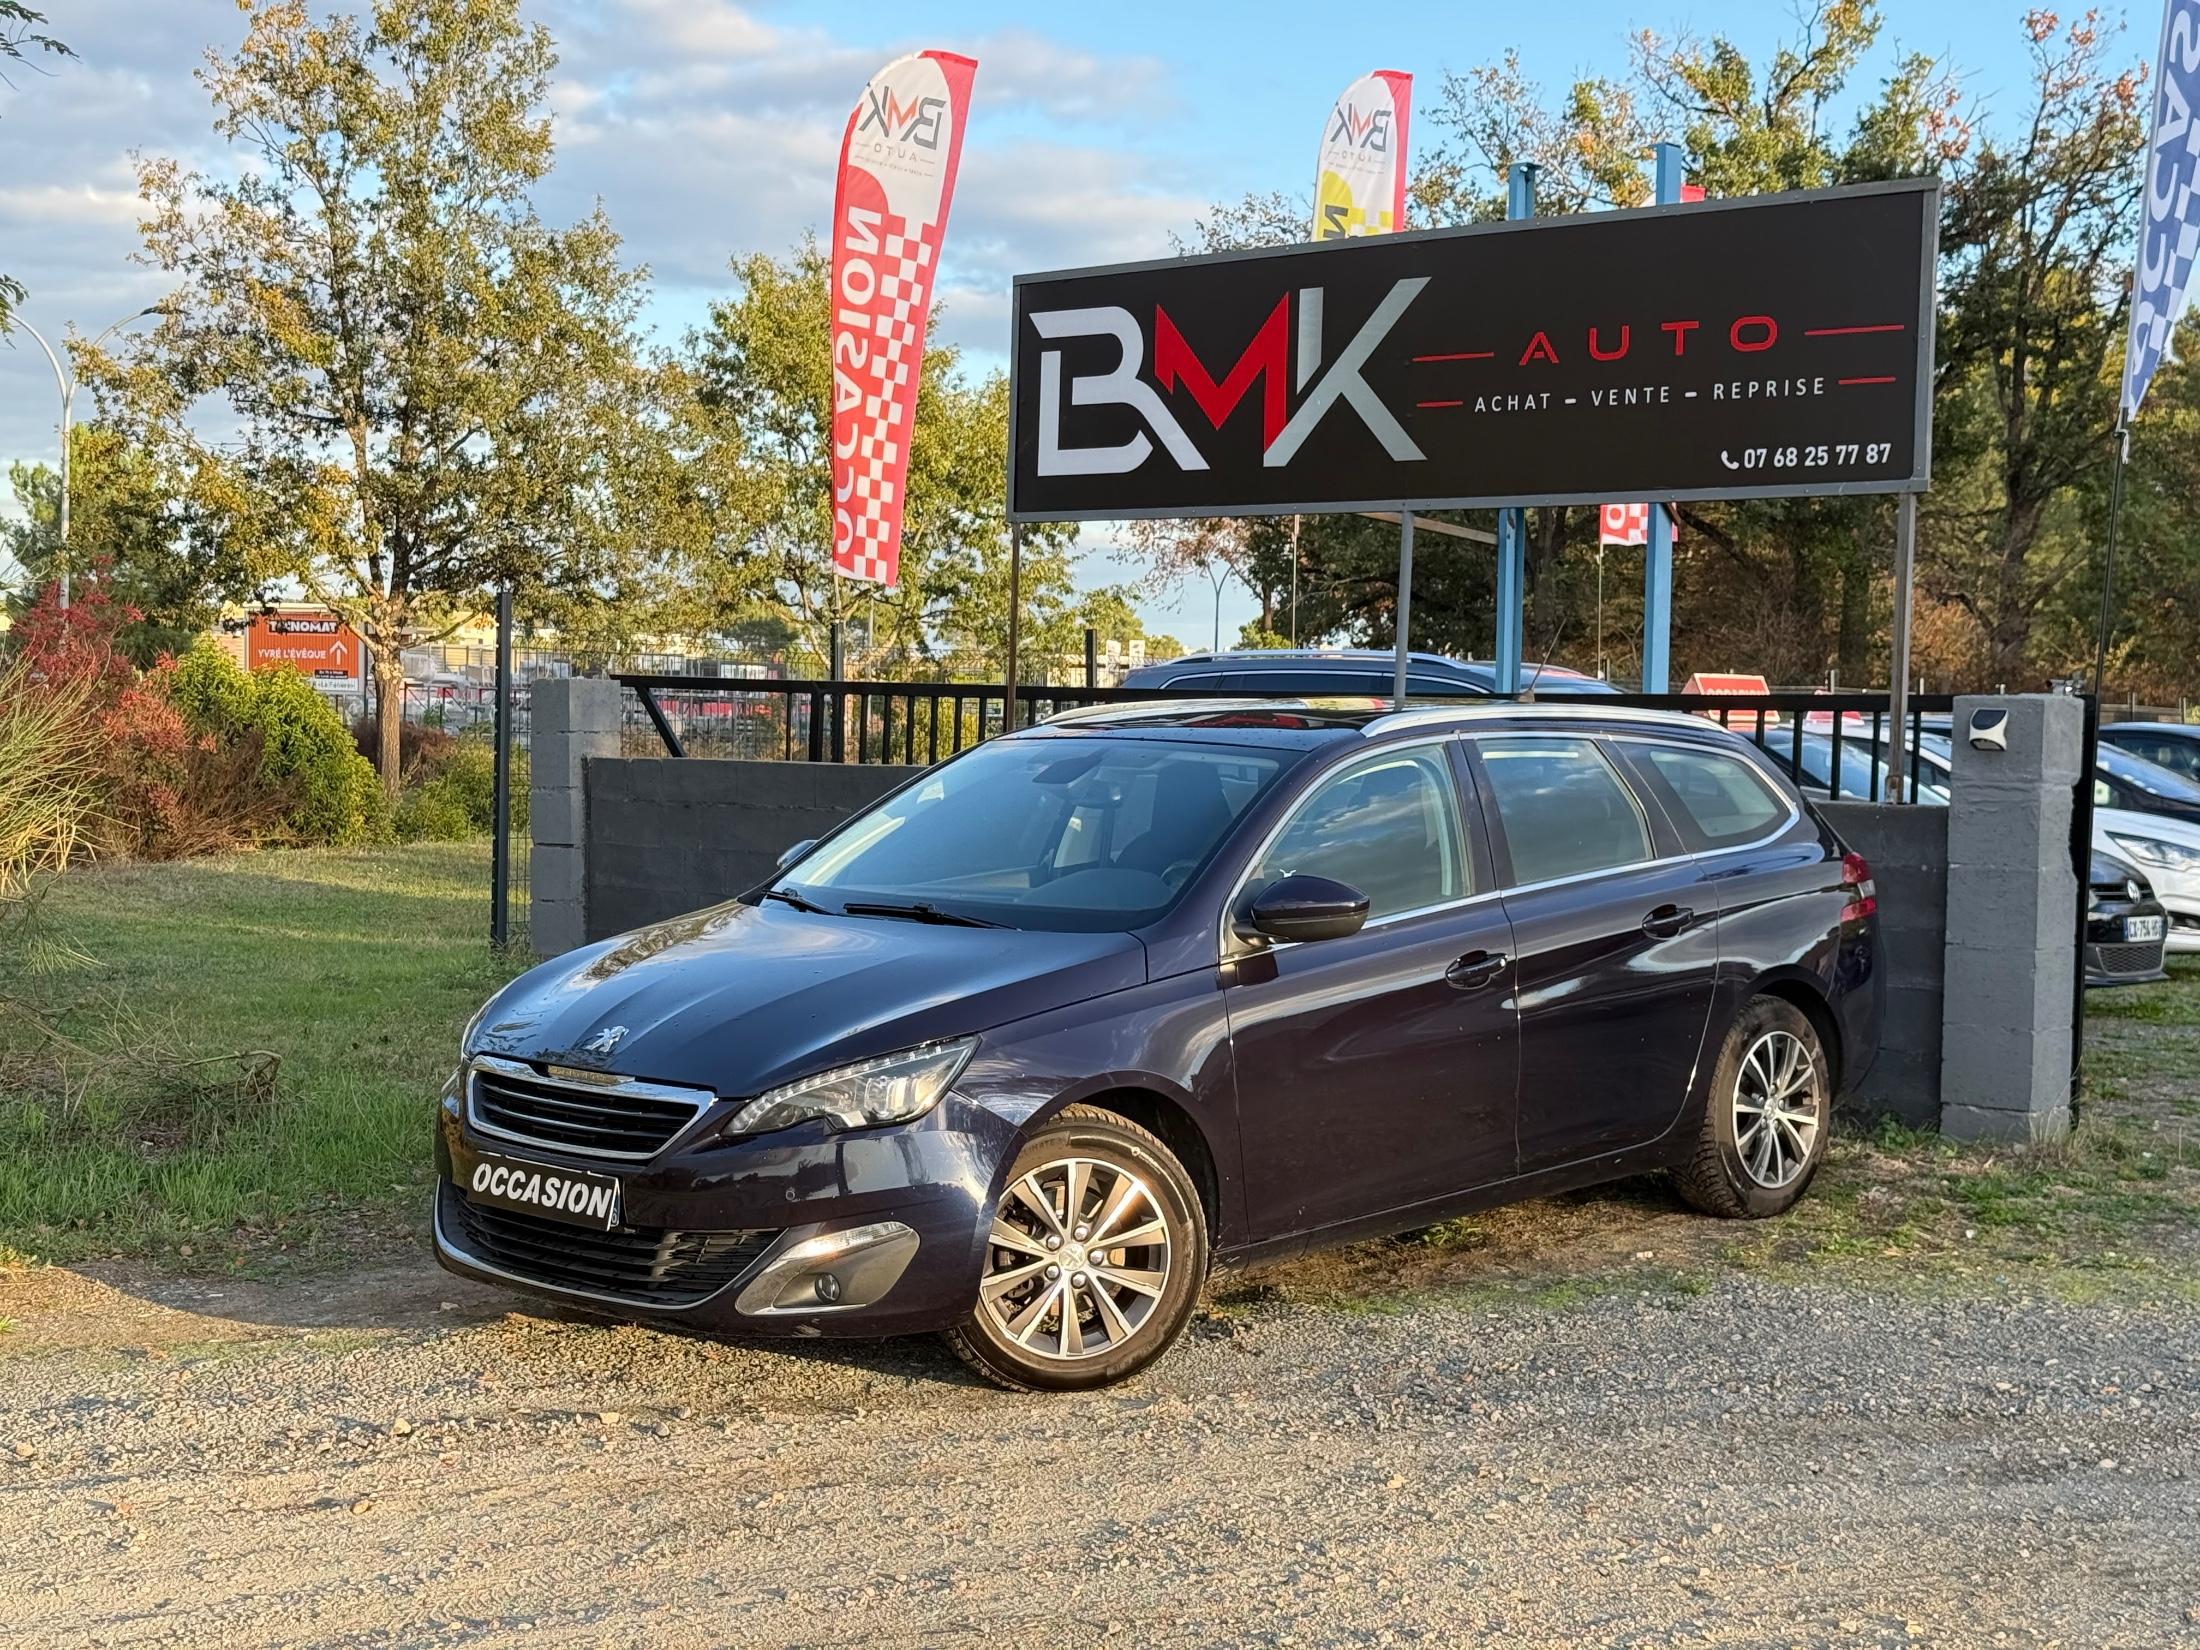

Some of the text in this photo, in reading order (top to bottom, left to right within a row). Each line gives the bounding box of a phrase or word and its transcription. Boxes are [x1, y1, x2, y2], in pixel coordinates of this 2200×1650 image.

[1519, 315, 1778, 366] AUTO
[1029, 276, 1432, 476] BMK
[1474, 392, 1551, 413] ACHAT
[1591, 386, 1670, 407] VENTE
[1713, 376, 1825, 401] REPRISE
[1744, 442, 1892, 469] 07 68 25 77 87
[472, 1162, 613, 1219] OCCASION
